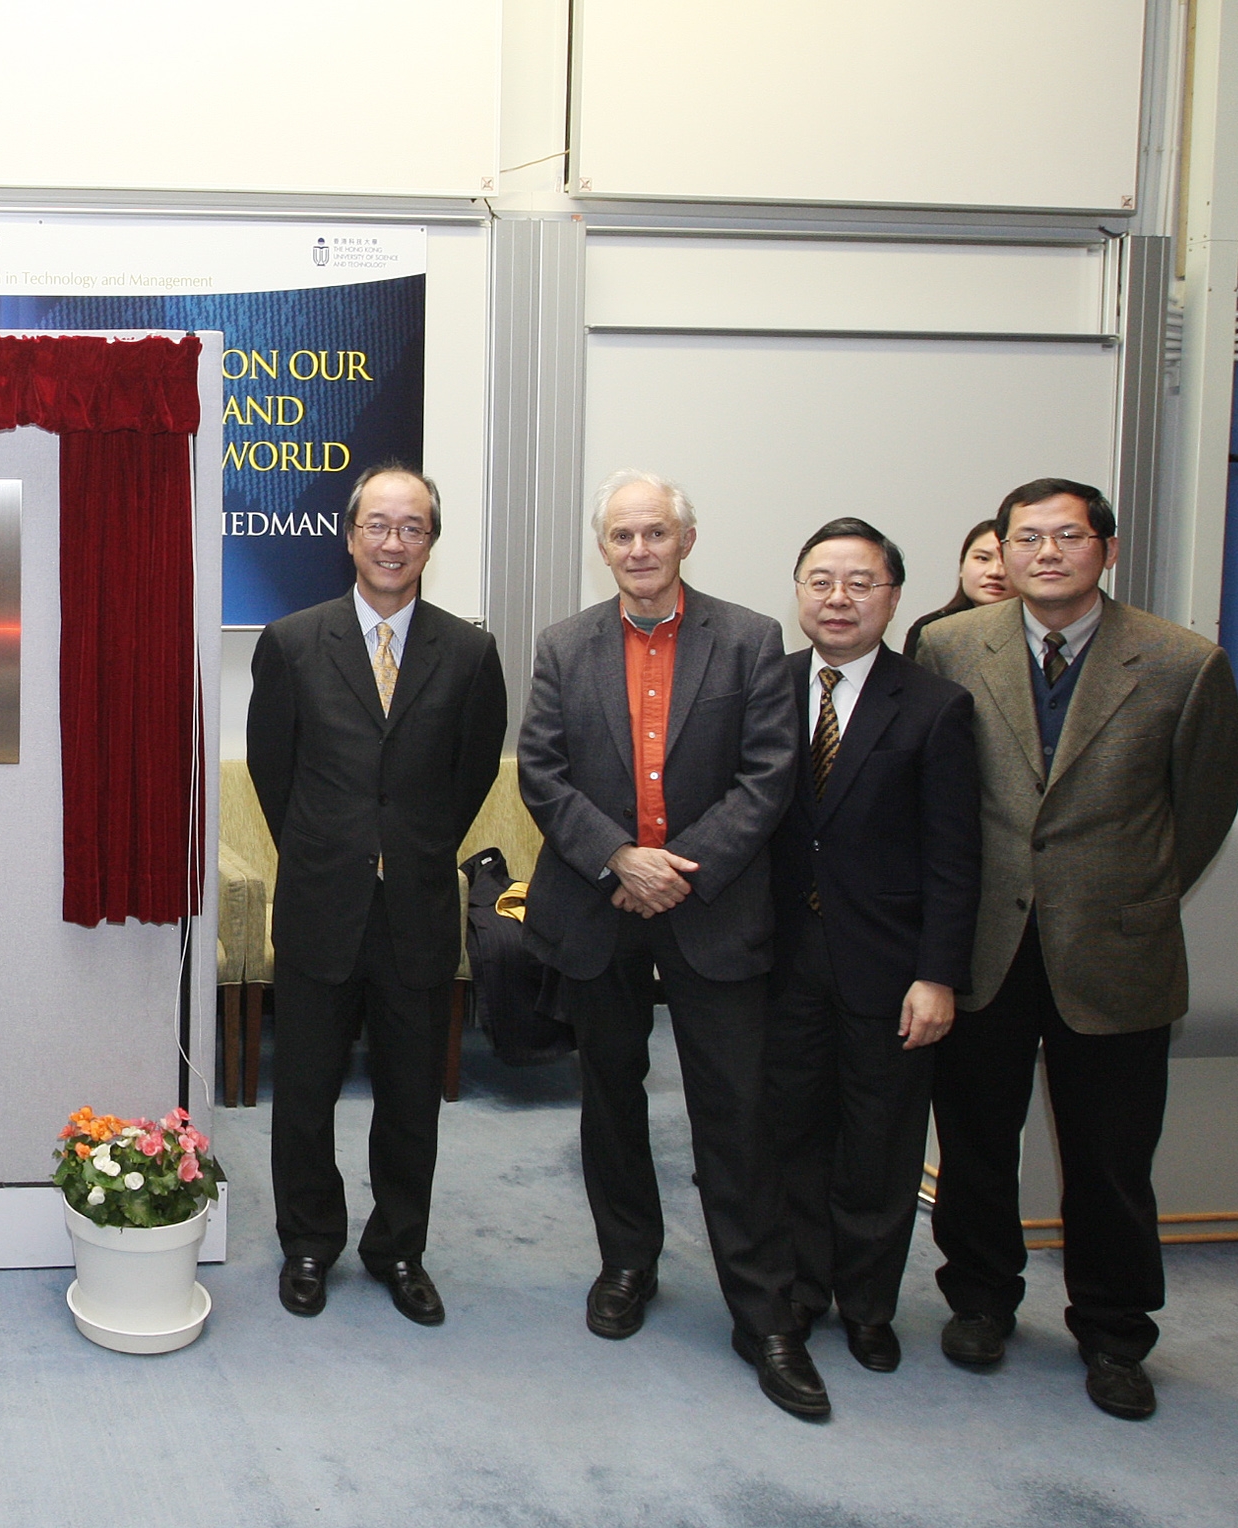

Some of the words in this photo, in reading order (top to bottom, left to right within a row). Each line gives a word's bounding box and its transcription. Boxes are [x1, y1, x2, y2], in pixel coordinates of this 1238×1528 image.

[6, 271, 17, 285] in
[22, 271, 97, 288] Technology
[101, 272, 125, 287] and
[129, 273, 213, 290] Management
[221, 349, 279, 380] ON
[289, 350, 374, 381] OUR
[222, 395, 305, 426] AND
[221, 441, 350, 472] WORLD
